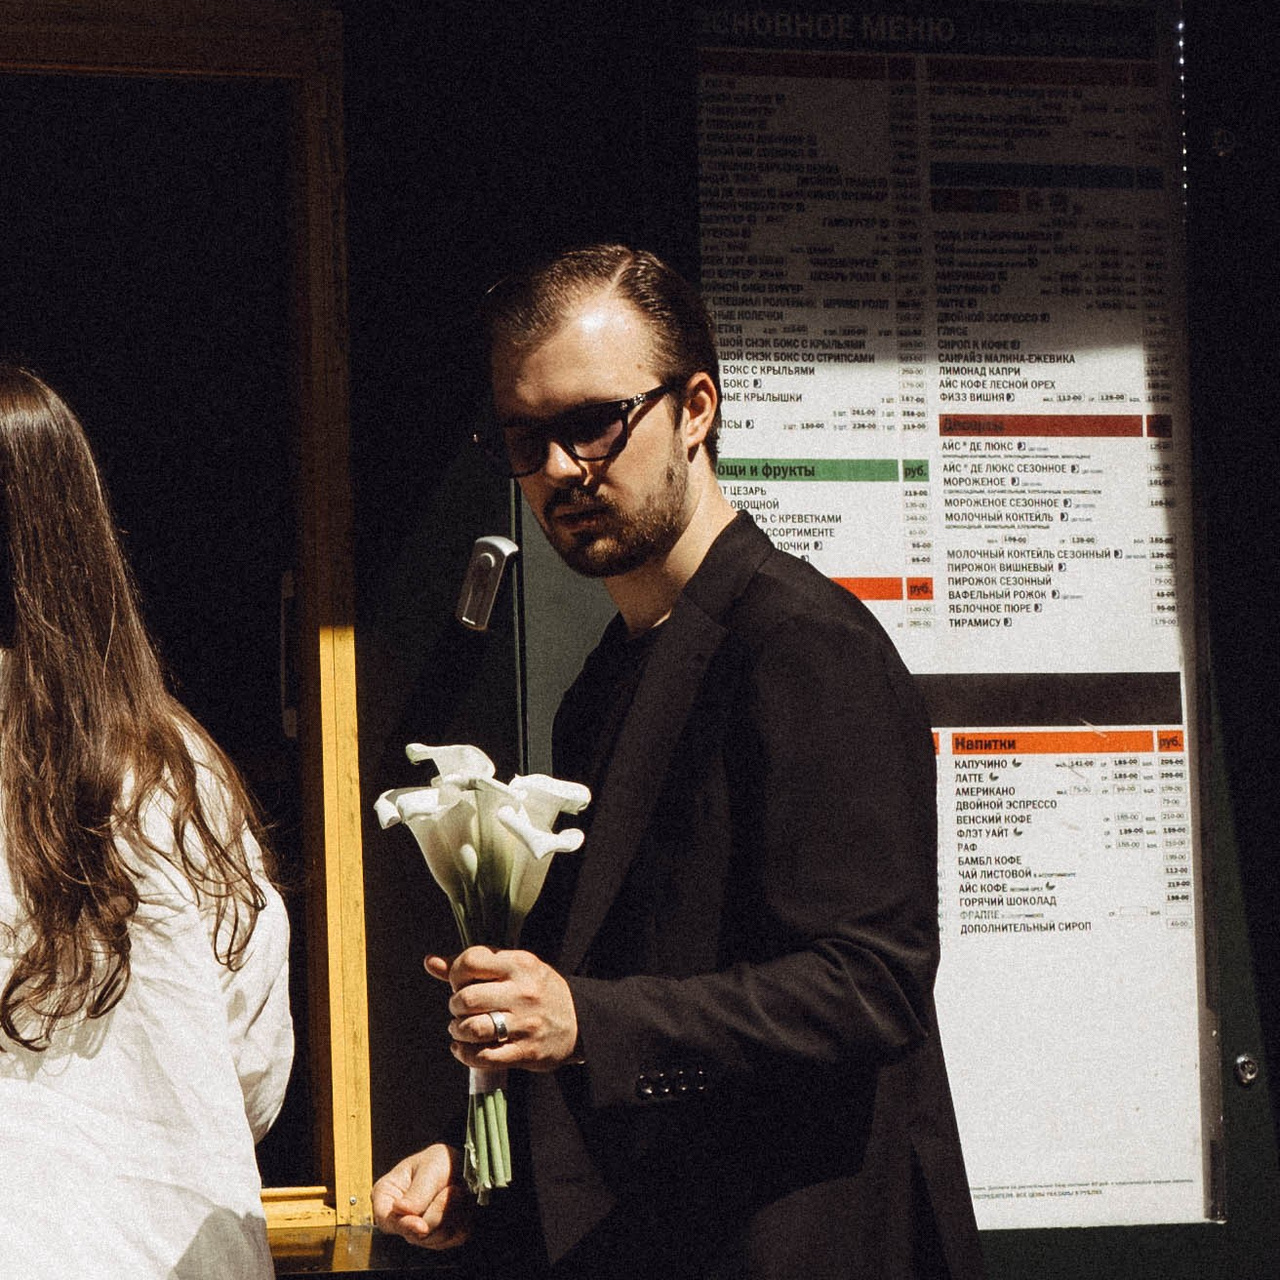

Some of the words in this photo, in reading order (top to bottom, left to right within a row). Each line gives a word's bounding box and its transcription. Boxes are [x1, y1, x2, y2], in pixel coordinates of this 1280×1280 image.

[862, 15, 956, 41] МЕНЮ
[746, 352, 771, 362] СНЭК
[774, 352, 799, 362] БОКС
[802, 352, 815, 362] СО
[817, 354, 874, 363] СТРИПСАМИ
[985, 354, 1075, 363] МАЛИНА-ЕЖЕВИКА
[723, 366, 749, 375] БОКС
[751, 366, 757, 375] С
[760, 366, 815, 375] КРЫЛЬЯМИ
[939, 367, 987, 377] ЛИМОНАД
[989, 367, 1020, 376] КАПРИ
[723, 380, 749, 388] БОКС
[940, 378, 958, 389] АЙС
[961, 380, 987, 389] КОФЕ
[990, 378, 1028, 389] ЛЕСНОЙ
[1031, 380, 1055, 389] ОРЕХ
[940, 393, 967, 401] ФИЗЗ
[970, 393, 1004, 401] ВИШНЯ
[970, 443, 981, 452] ДЕ
[984, 442, 1013, 450] ЛЮКС
[719, 465, 745, 476] ощи
[750, 466, 758, 474] и
[762, 463, 815, 479] фрукты
[904, 466, 927, 477] руб.
[970, 465, 983, 474] ДЕ
[986, 464, 1014, 473] ЛЮКС
[1017, 464, 1066, 473] СЕЗОННОЕ
[943, 477, 1005, 486] МОРОЖЕНОЕ
[730, 486, 766, 496] ЦЕЗАРЬ
[730, 498, 779, 509] ОВОЩНОЙ
[945, 498, 1006, 507] МОРОЖЕНОЕ
[1009, 498, 1059, 507] СЕЗОННОЕ
[945, 510, 1003, 521] МОЛОЧНЫЙ
[1006, 510, 1053, 521] КОКТЕЙЛЬ
[777, 542, 810, 550] ЛОЧКИ
[947, 548, 1004, 559] МОЛОЧНЫЙ
[1008, 548, 1054, 559] КОКТЕЙЛЬ
[1057, 548, 1111, 559] СЕЗОННЫЙ
[948, 563, 996, 572] ПИРОЖОК
[1000, 561, 1054, 571] ВИШНЕВЫЙ
[948, 577, 997, 585] ПИРОЖОК
[1000, 574, 1052, 585] СЕЗОННЫЙ
[949, 588, 1010, 600] ВАФЕЛЬНЫЙ
[1013, 590, 1046, 599] РОЖОК
[949, 604, 1002, 613] ЯБЛОЧНОЕ
[1004, 604, 1031, 613] ПЮРЕ
[949, 619, 1000, 627] ТИРАМИСУ
[955, 737, 1016, 750] Напитки
[1159, 738, 1181, 749] руб.
[954, 760, 1007, 769] КАПУЧИНО
[955, 774, 984, 783] ЛАТТЕ
[955, 787, 1015, 796] АМЕРИКАНО
[956, 799, 1002, 810] ДВОЙНОЙ
[1006, 800, 1057, 810] ЭСПРЕССО
[956, 814, 1001, 824] ВЕНСКИЙ
[1004, 814, 1031, 824] КОФЕ
[957, 828, 983, 838] ФЛЭТ
[985, 827, 1008, 837] УАЙТ
[958, 843, 978, 852] РАФ
[958, 856, 992, 865] БАМБЛ
[995, 856, 1022, 865] КОФЕ
[959, 869, 978, 879] ЧАЙ
[980, 869, 1032, 879] ЛИСТОВОЙ
[959, 883, 978, 893] АЙС
[980, 883, 1008, 892] КОФЕ
[960, 897, 1004, 907] ГОРЯЧИЙ
[1007, 896, 1057, 906] ШОКОЛАД
[961, 924, 1055, 935] ДОПОЛНИТЕЛЬНЫЙ
[1058, 922, 1092, 931] СИРОП
